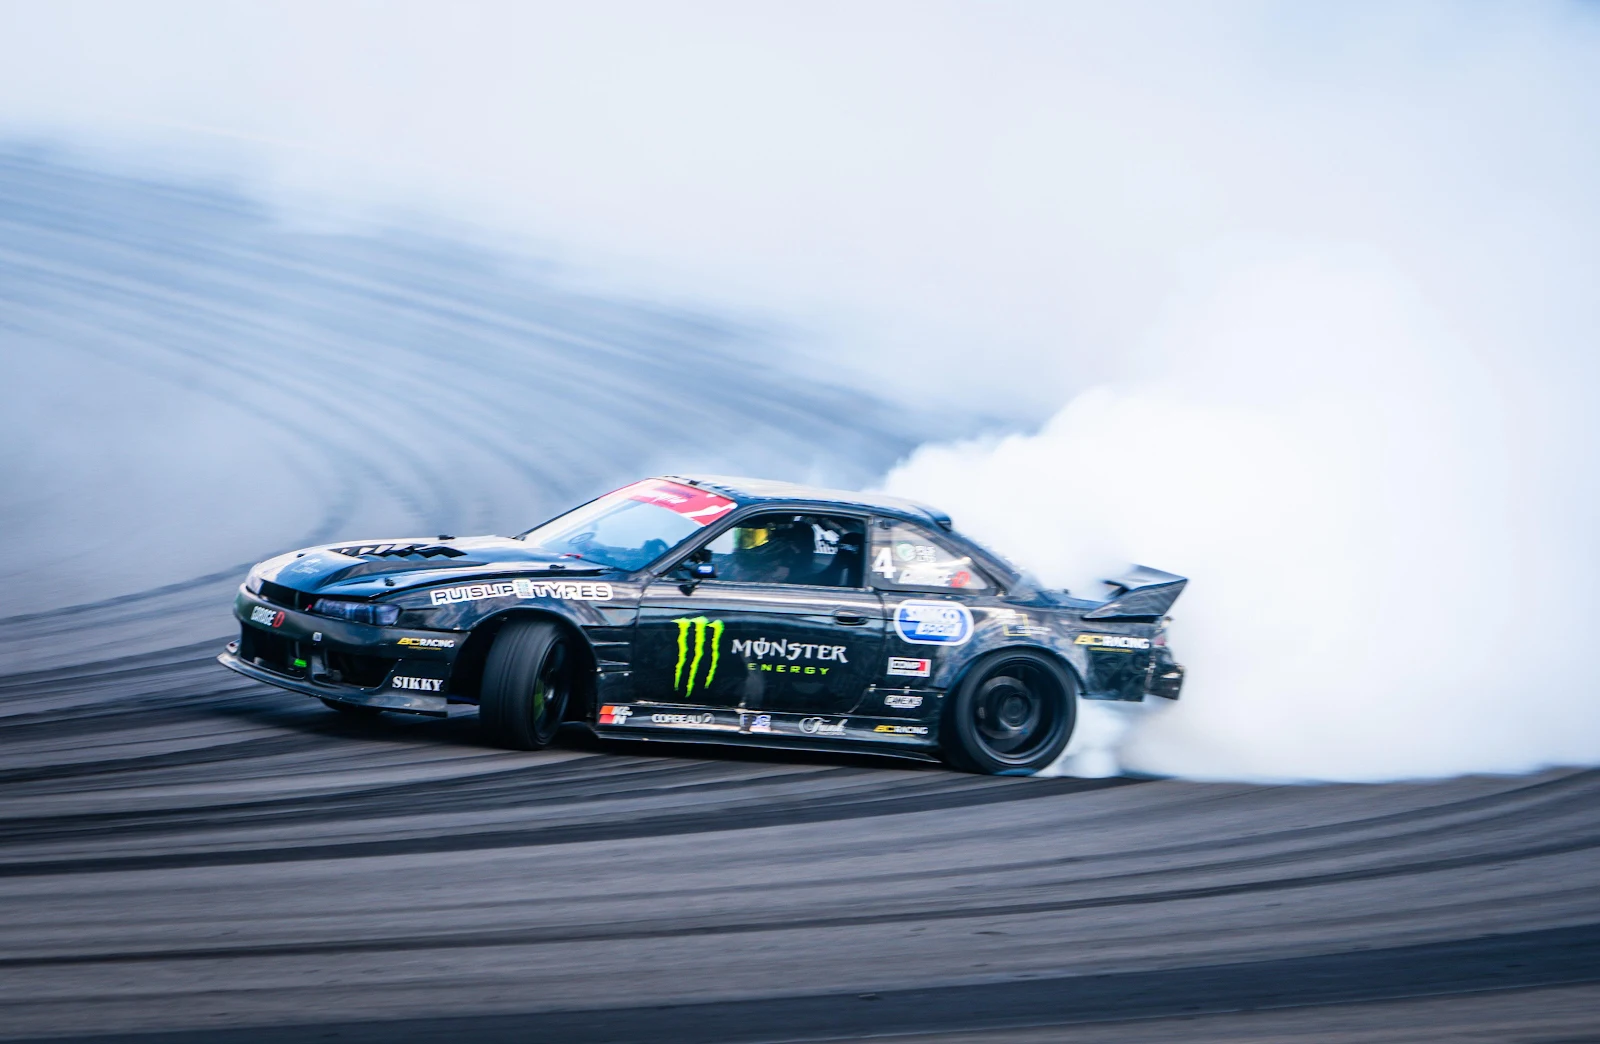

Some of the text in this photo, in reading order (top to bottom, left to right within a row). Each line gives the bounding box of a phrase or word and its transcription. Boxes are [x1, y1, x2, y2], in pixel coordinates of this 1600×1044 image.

[872, 547, 897, 579] 4
[432, 581, 612, 604] RUISLIP TYRES
[731, 637, 849, 663] MONSTER
[747, 662, 830, 675] ENERGY
[391, 675, 443, 692] SIKKY
[651, 712, 701, 724] CORBEAU
